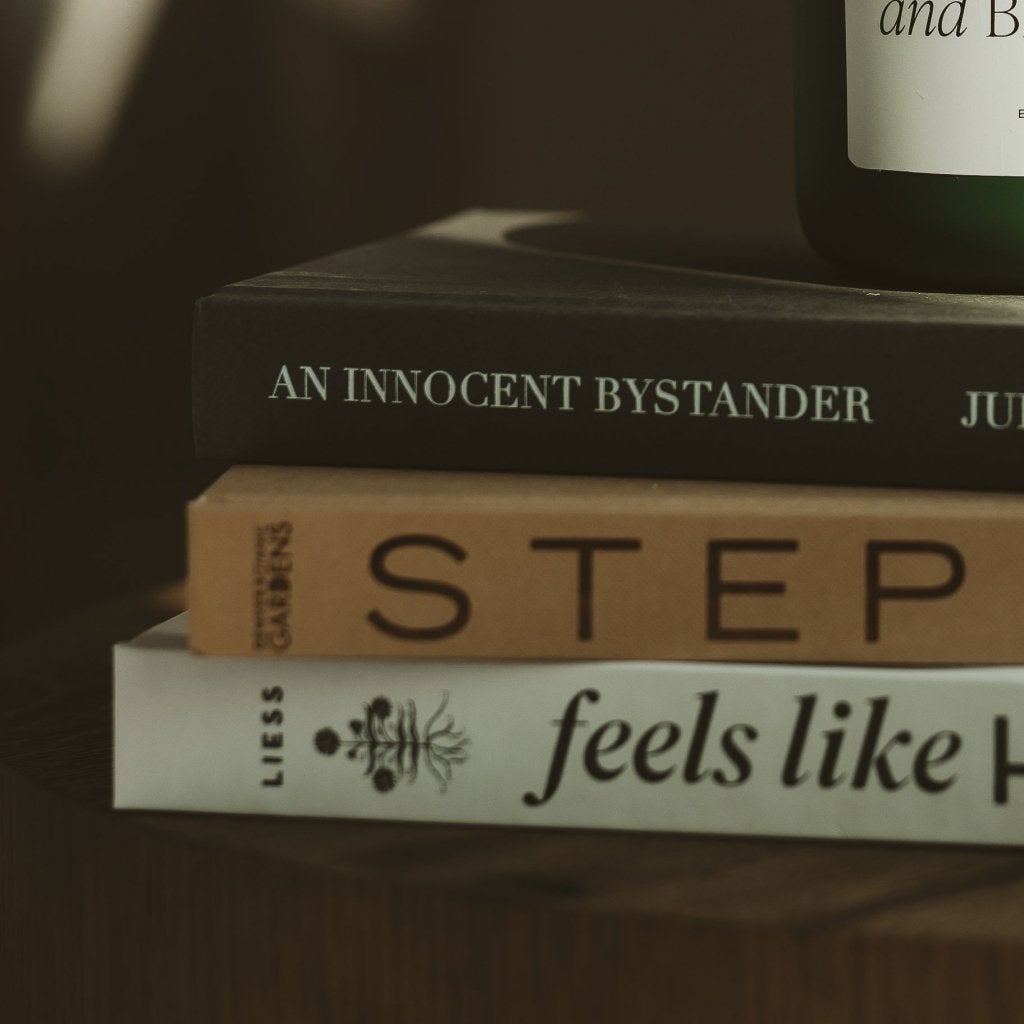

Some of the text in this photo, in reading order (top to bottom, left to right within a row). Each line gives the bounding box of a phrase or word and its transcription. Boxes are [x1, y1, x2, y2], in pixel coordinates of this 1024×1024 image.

[268, 364, 872, 423] AN INNOCENT BYSTANDER
[260, 685, 284, 788] LIESS
[521, 689, 758, 808] feels
[781, 694, 962, 795] like
